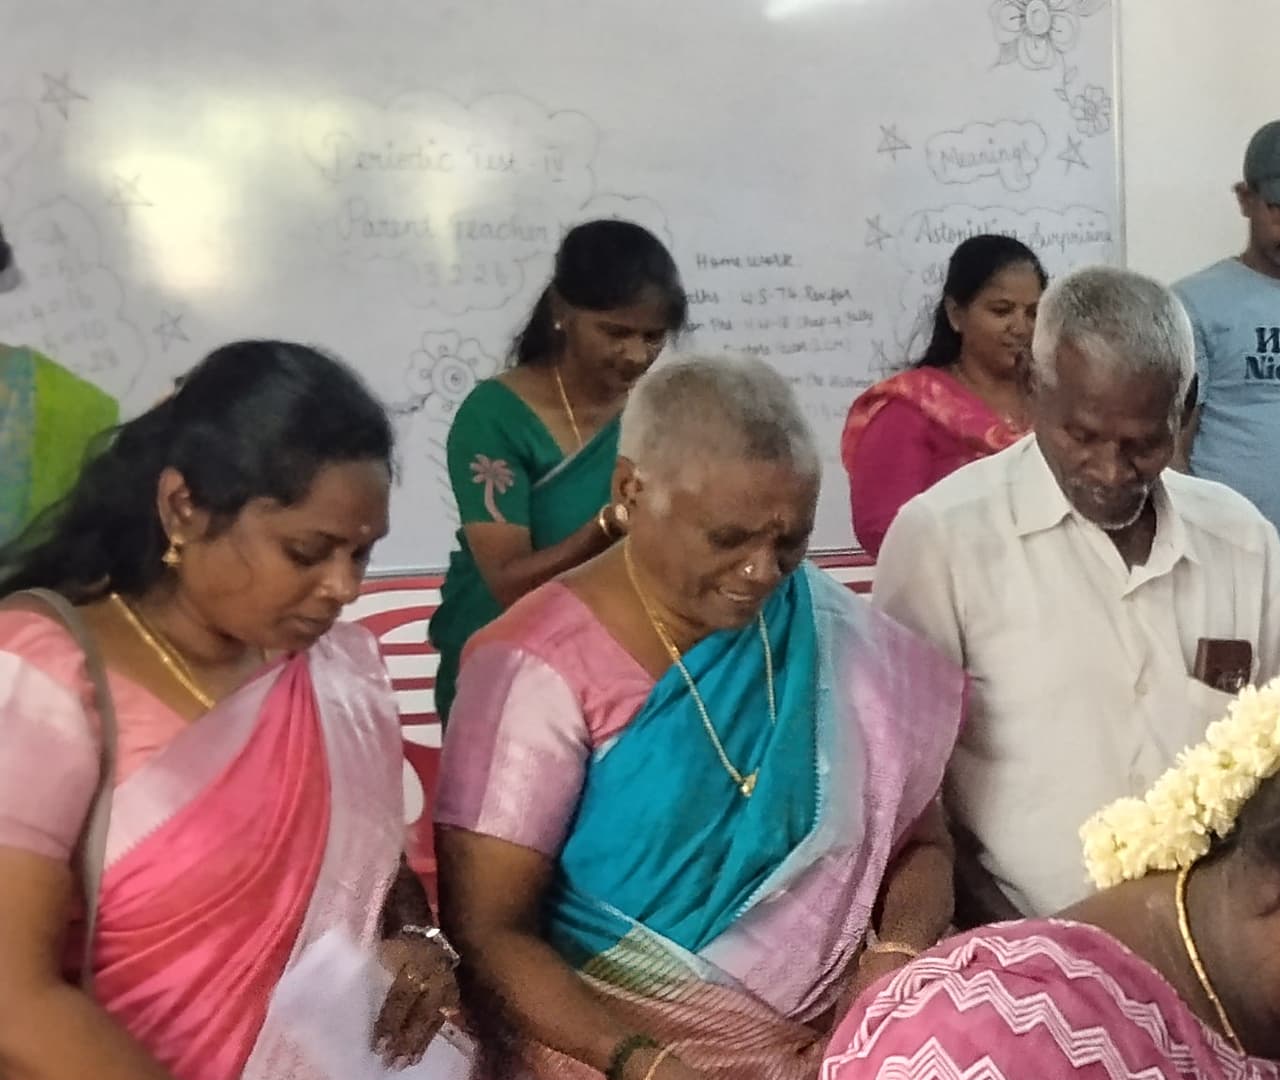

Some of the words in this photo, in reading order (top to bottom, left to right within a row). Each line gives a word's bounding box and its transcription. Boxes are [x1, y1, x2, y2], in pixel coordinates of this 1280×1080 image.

[321, 128, 454, 181] Periodic
[466, 143, 520, 174] Test
[340, 196, 436, 241] Parent
[685, 288, 720, 304] aths
